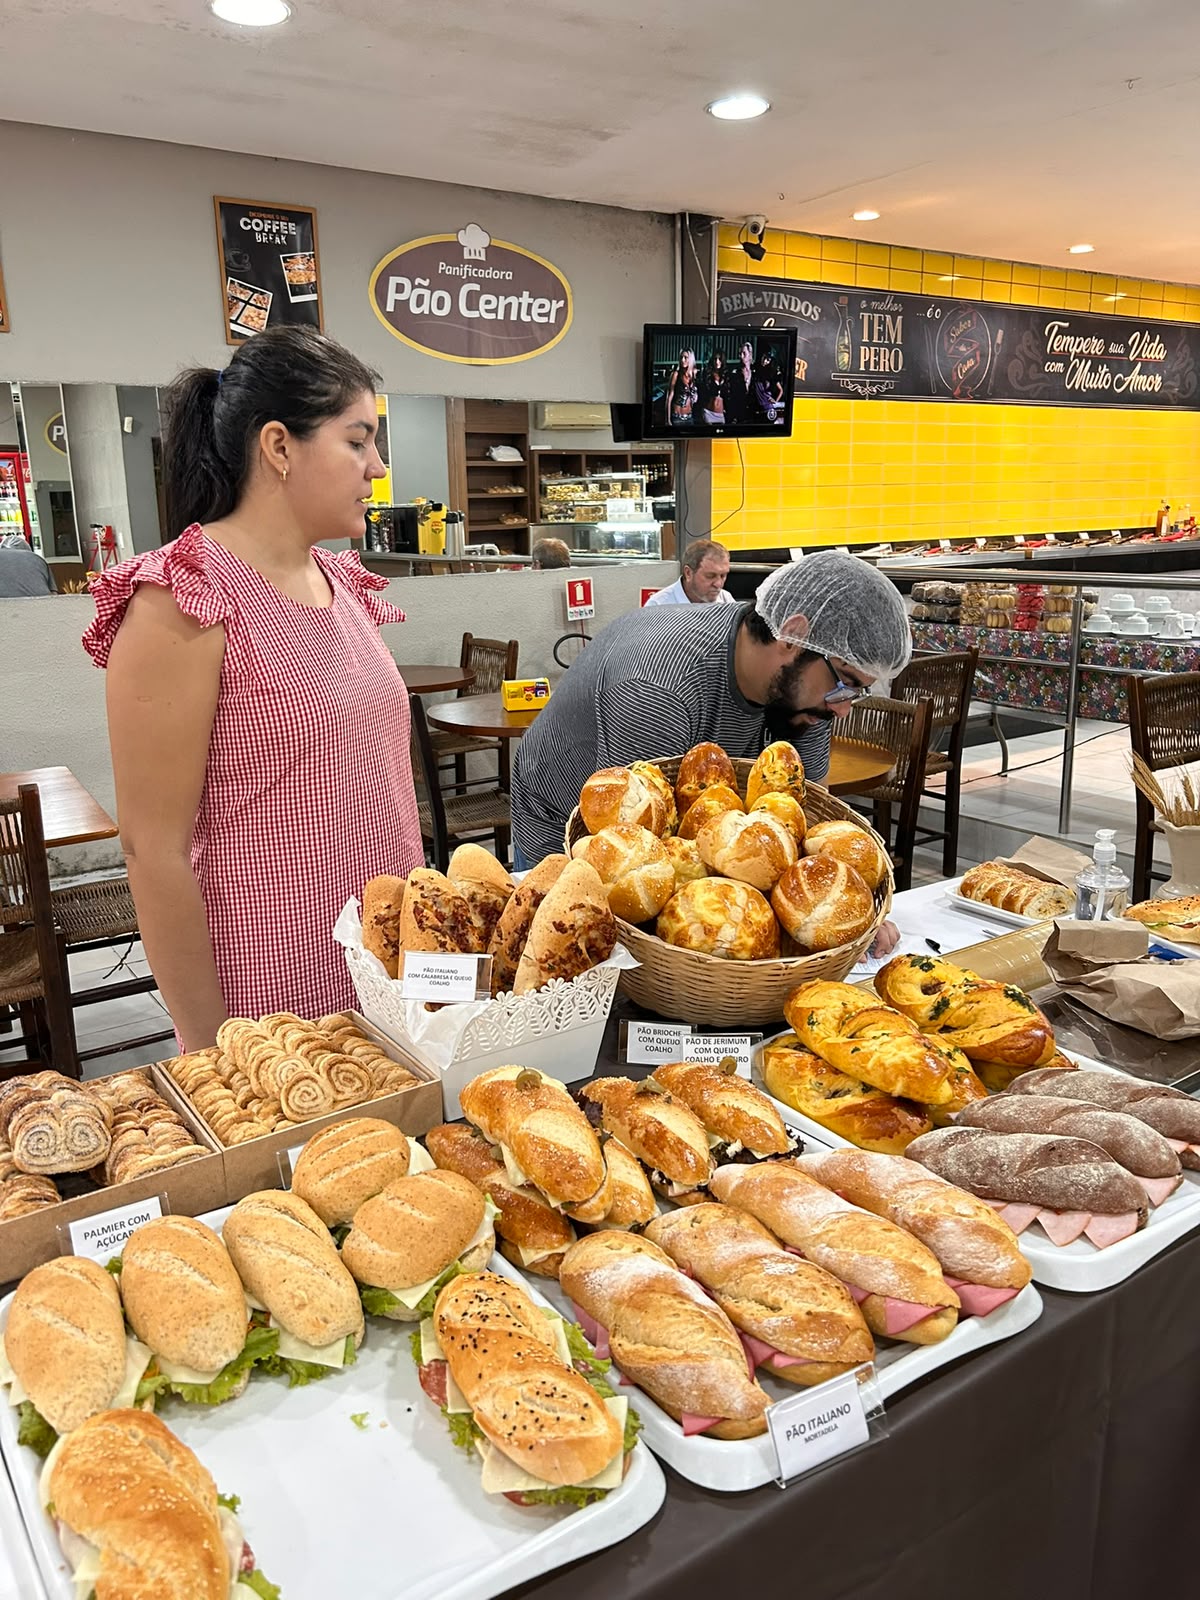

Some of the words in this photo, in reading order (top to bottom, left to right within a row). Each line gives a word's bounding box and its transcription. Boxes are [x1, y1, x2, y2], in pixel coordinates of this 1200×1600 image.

[240, 217, 296, 235] COFFEE
[255, 232, 288, 245] BREAK
[438, 262, 513, 281] Panificadora
[386, 276, 452, 316] Pão
[459, 283, 565, 324] Center
[720, 291, 822, 322] BEM-VINDOS
[871, 295, 904, 312] melhor
[859, 312, 904, 345] TEM
[1044, 321, 1105, 361] Tempere
[1108, 341, 1126, 355] sua
[1127, 330, 1167, 361] Vida
[859, 345, 904, 373] PERO
[1044, 359, 1065, 373] com
[1065, 358, 1112, 390] Muito
[1113, 361, 1163, 394] Amor
[645, 1045, 673, 1053] COALHO
[656, 1037, 680, 1046] QUEIJO
[84, 1221, 126, 1240] PALMIER
[128, 1213, 151, 1226] COM
[786, 1423, 806, 1441] PÃO
[808, 1403, 851, 1431] ITALIANO
[804, 1423, 839, 1443] MORTADELA
